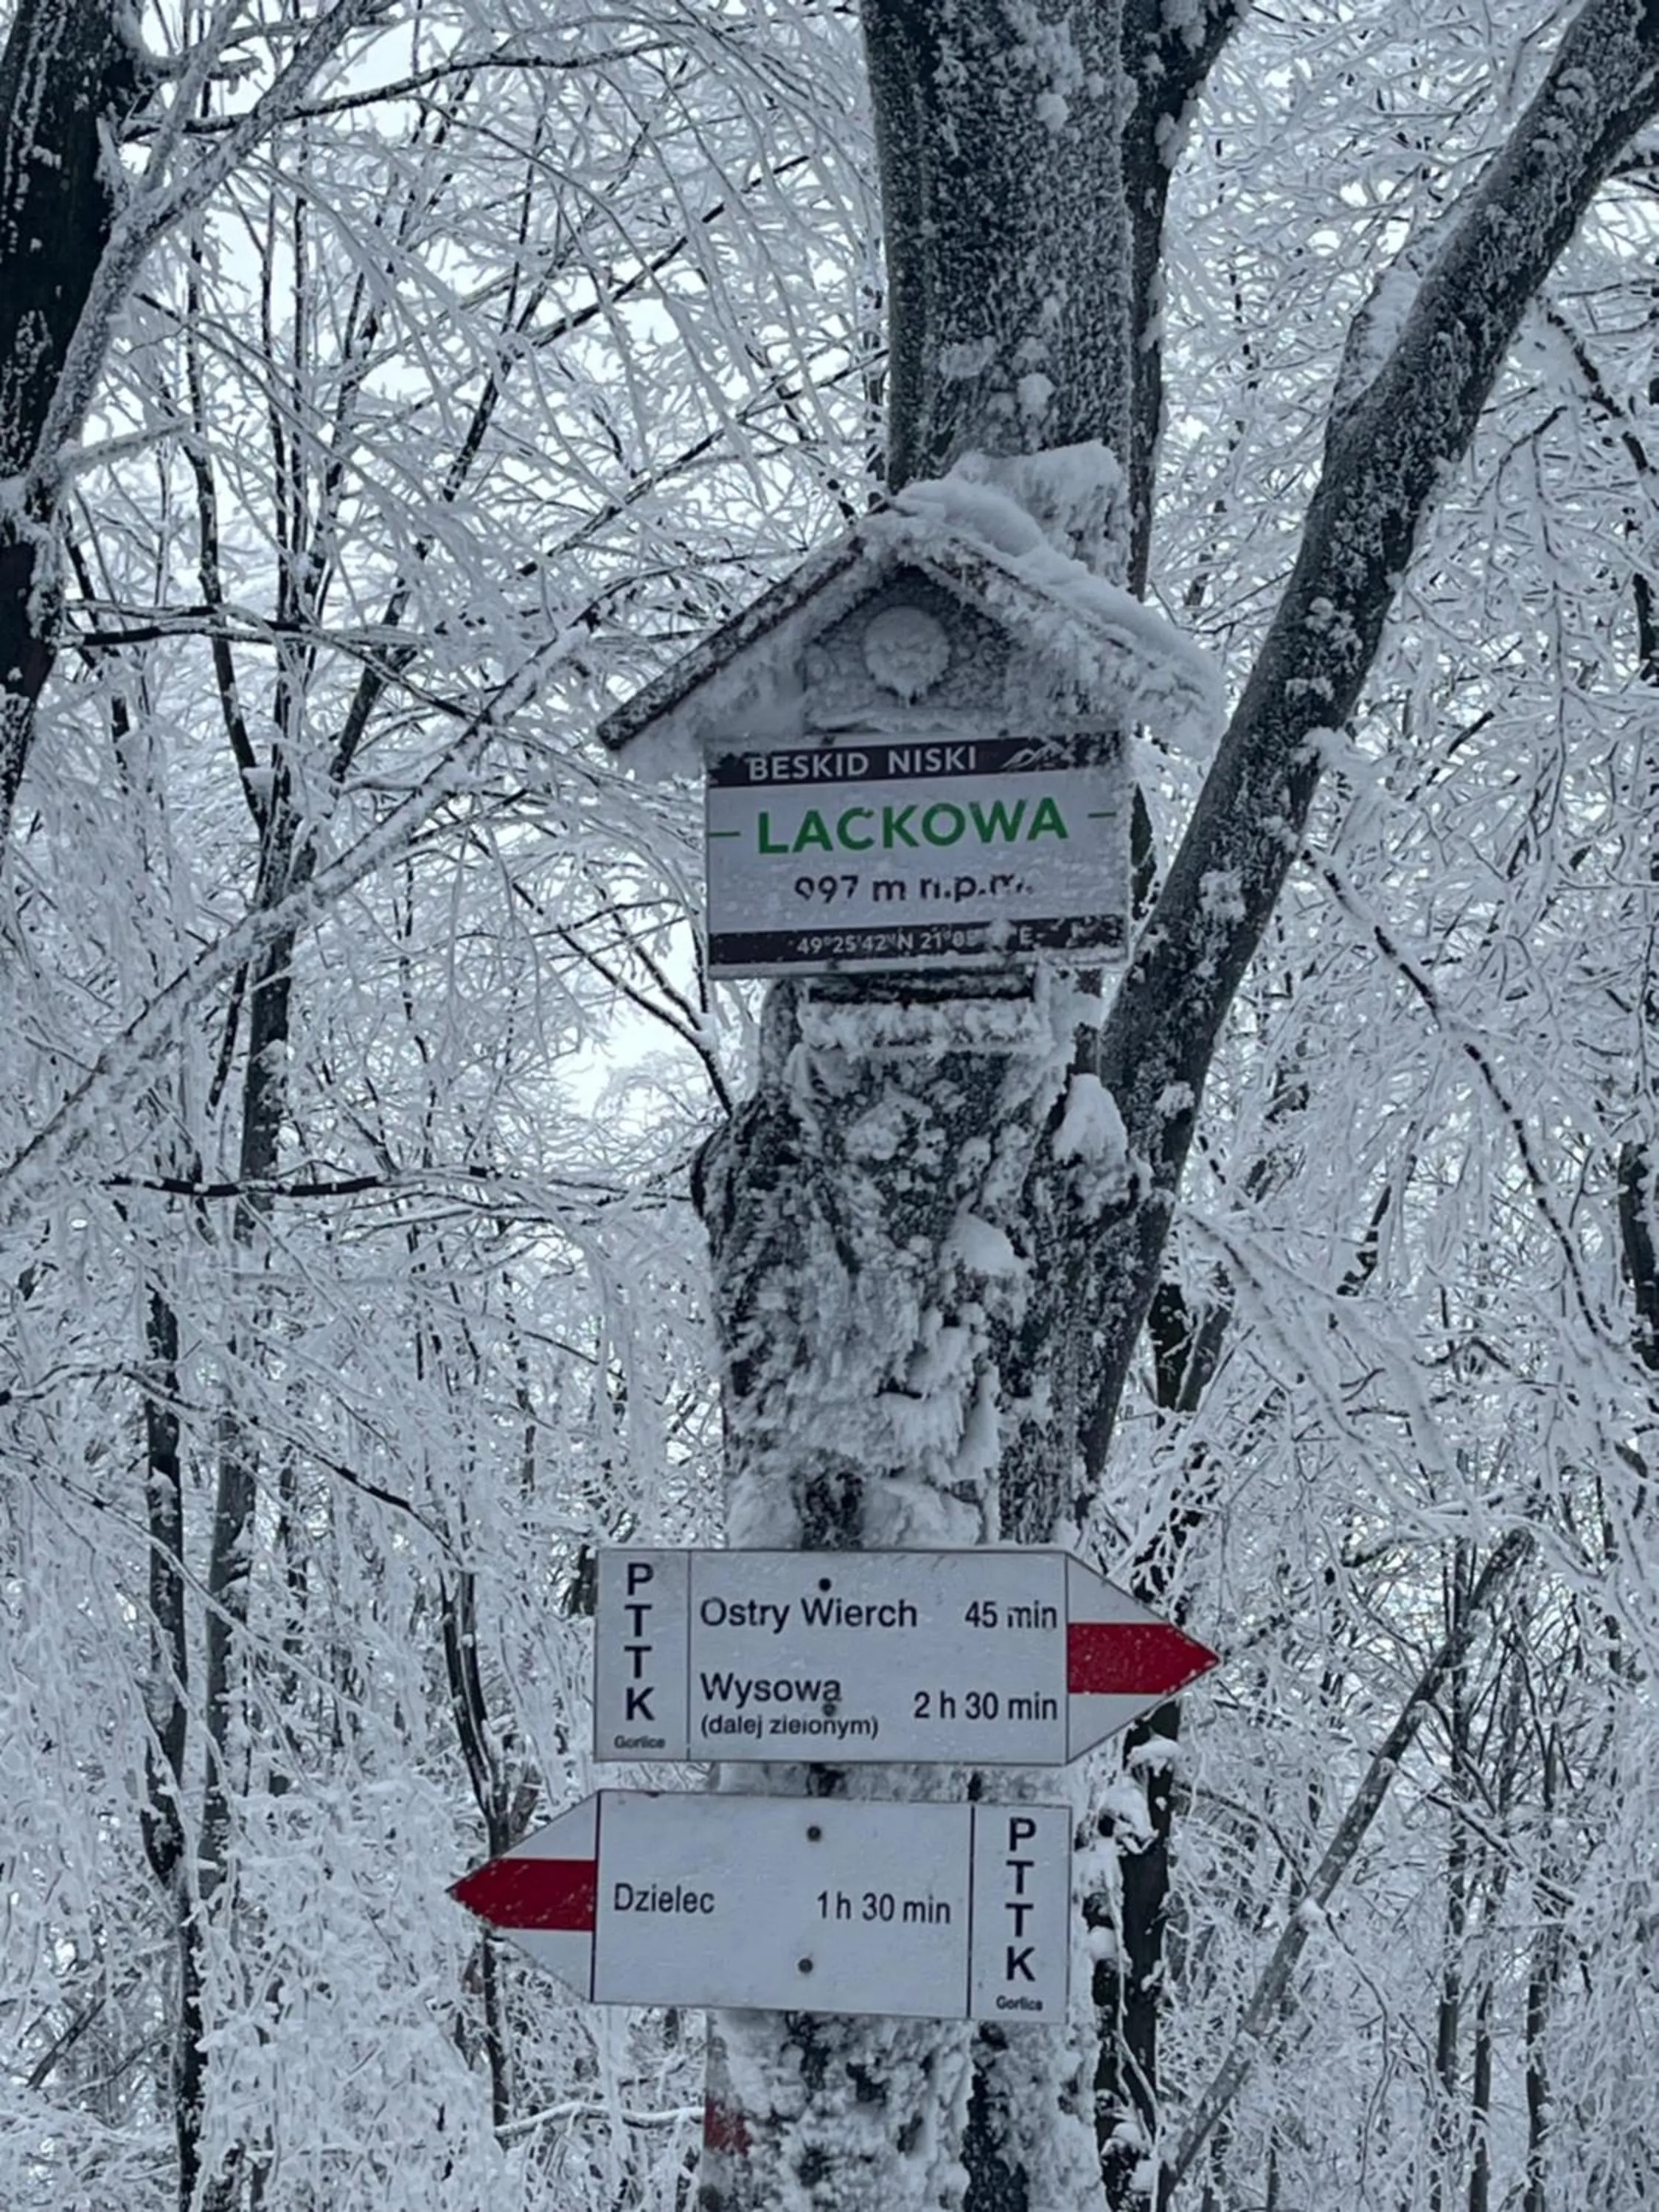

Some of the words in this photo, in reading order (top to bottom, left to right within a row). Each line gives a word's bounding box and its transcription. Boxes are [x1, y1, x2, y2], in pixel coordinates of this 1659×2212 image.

[746, 752, 870, 782] BESKID
[887, 746, 977, 775] NISKI
[758, 796, 1069, 855] LACKOWA
[872, 879, 907, 902] m
[700, 1596, 790, 1634] Ostry
[801, 1596, 918, 1628] Wierch
[964, 1601, 998, 1629] 45
[1007, 1601, 1057, 1629] min
[700, 1672, 841, 1709] Wysowa
[914, 1692, 931, 1719] 2
[940, 1691, 956, 1719] h
[965, 1691, 998, 1720] 30
[1008, 1691, 1057, 1720] min
[700, 1713, 763, 1740] (dalej
[613, 1883, 715, 1915] Dzielec
[817, 1890, 828, 1919] 1
[836, 1891, 851, 1920] h
[862, 1892, 895, 1922] 30
[902, 1893, 951, 1924] min
